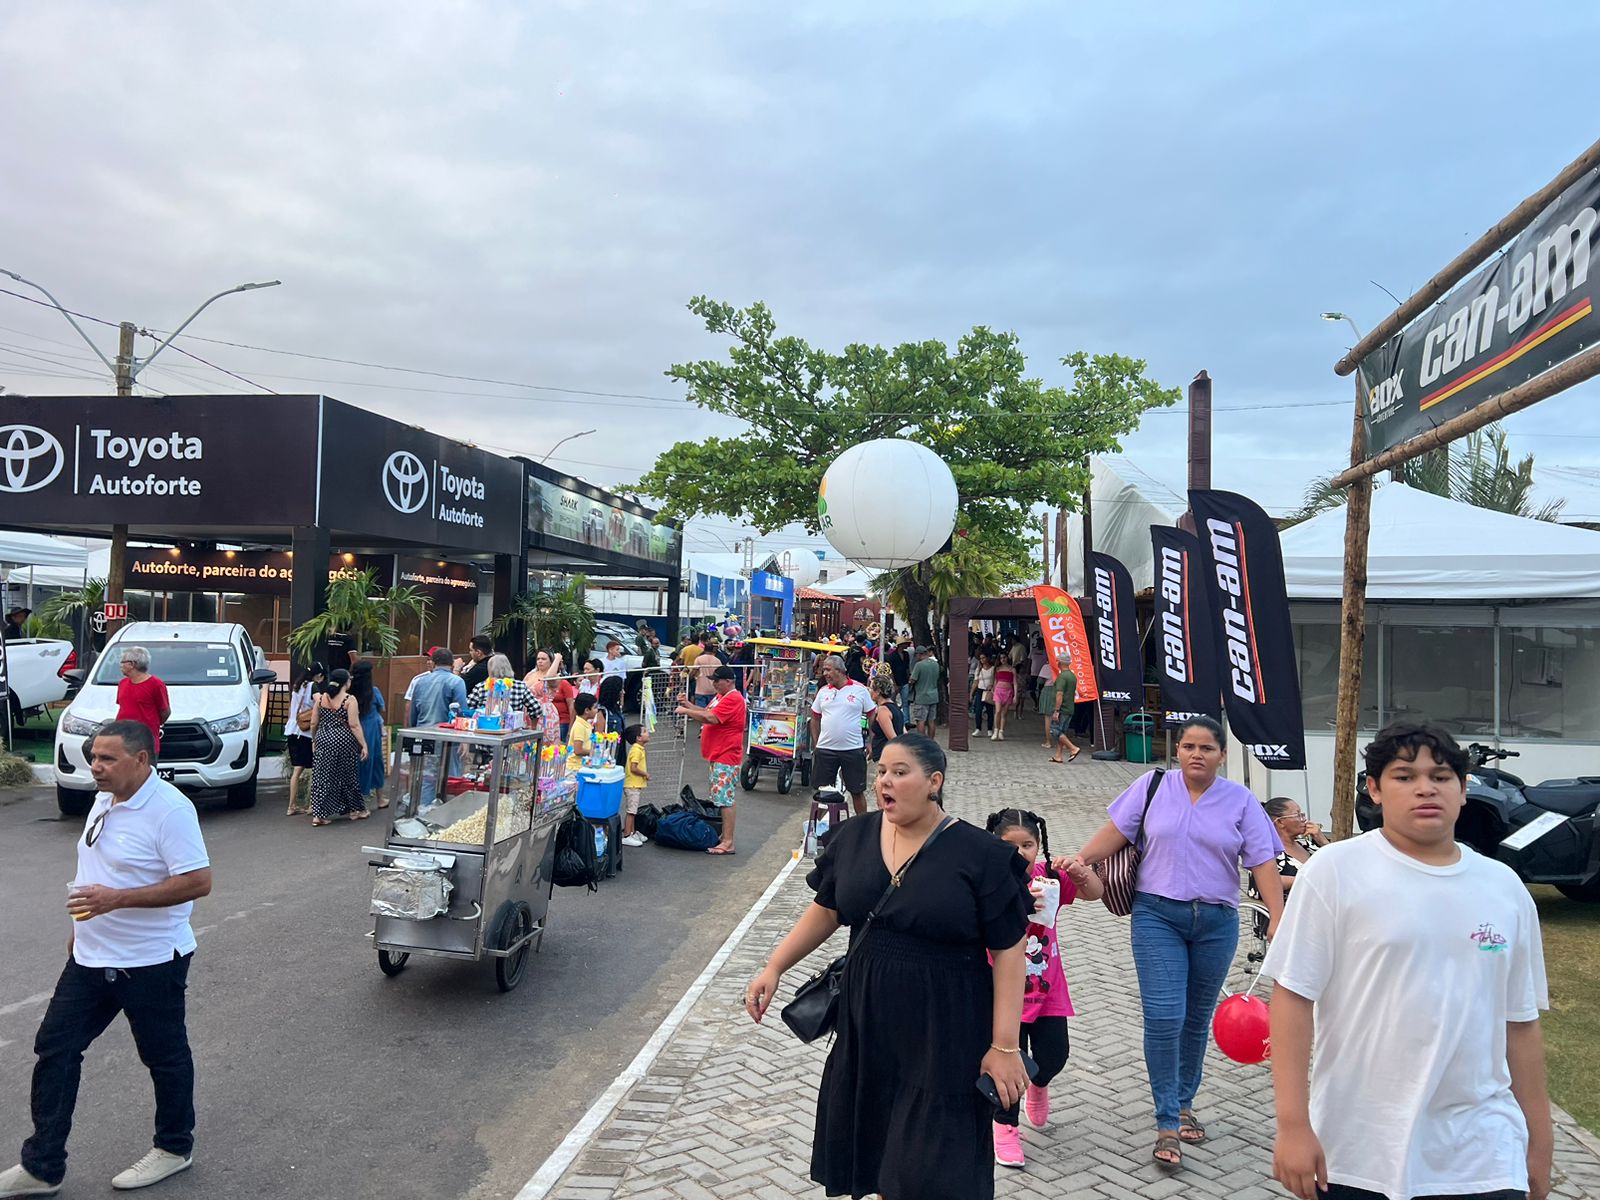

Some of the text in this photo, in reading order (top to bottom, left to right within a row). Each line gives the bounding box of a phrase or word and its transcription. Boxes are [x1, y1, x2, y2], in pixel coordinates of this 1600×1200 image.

[1419, 206, 1597, 388] can-am
[1370, 368, 1404, 416] BOX
[90, 429, 203, 467] Toyota
[89, 473, 202, 496] Autoforte
[440, 465, 485, 501] Toyota
[438, 503, 484, 528] Autoforte
[132, 561, 200, 577] Autoforte,
[202, 564, 256, 581] parceira
[259, 565, 277, 578] do
[1094, 567, 1116, 671] can-am
[1161, 546, 1186, 683] can-am
[1206, 517, 1256, 704] can-am
